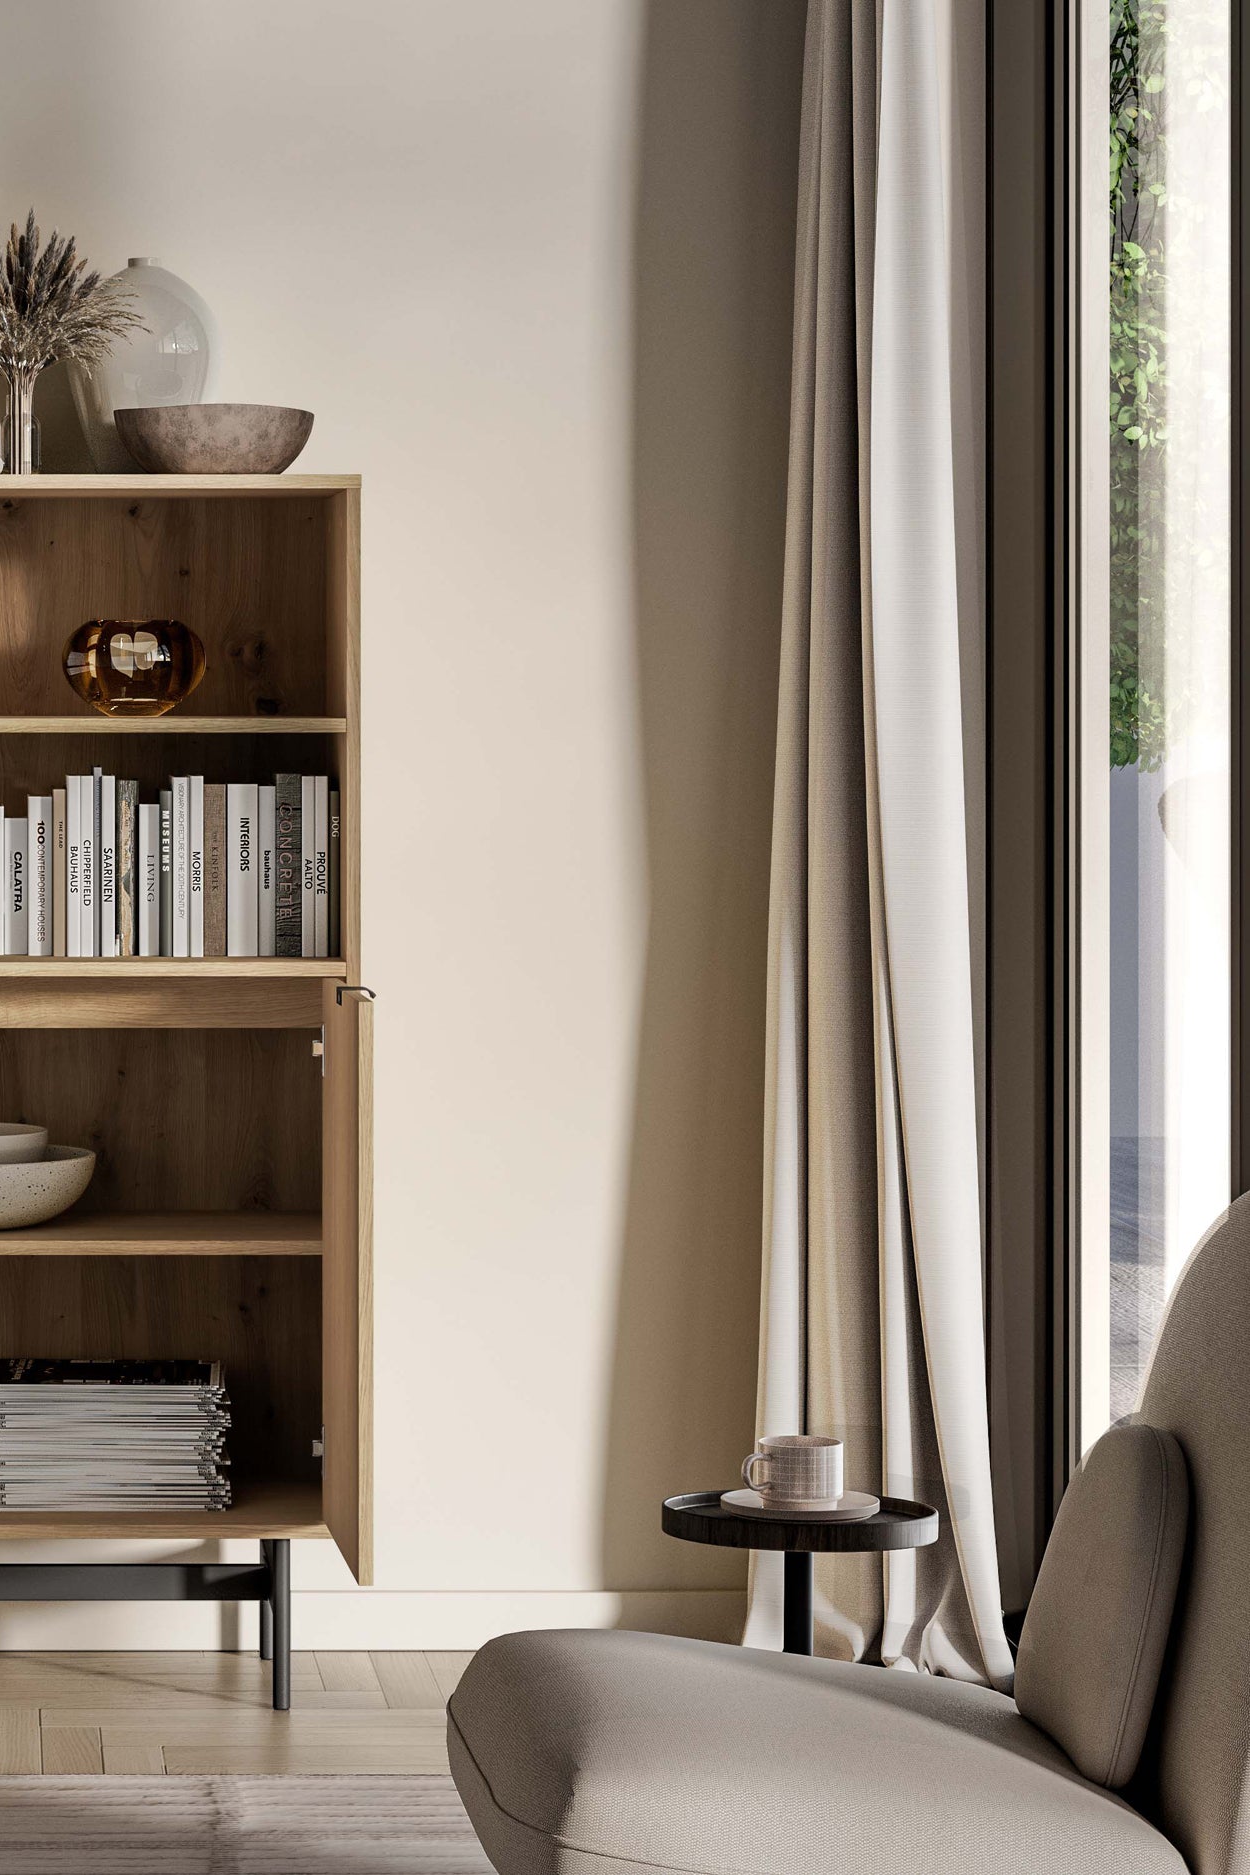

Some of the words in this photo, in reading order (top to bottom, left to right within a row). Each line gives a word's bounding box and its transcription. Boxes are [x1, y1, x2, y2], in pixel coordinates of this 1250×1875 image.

[162, 810, 170, 872] MUSEUMS
[240, 817, 250, 872] INTERIORS
[332, 816, 340, 838] DOG
[13, 851, 23, 912] CALATRA
[70, 846, 79, 893] BAUHAUS
[83, 839, 92, 907] CHIPPERFIELD
[103, 848, 113, 903] SAARINEN
[146, 854, 155, 903] LIVING
[192, 851, 201, 892] MORRIS
[211, 846, 219, 892] KINFOLK
[264, 850, 272, 890] bauhaus
[279, 804, 293, 918] CONCRETE
[304, 858, 313, 890] AALTO
[316, 851, 328, 895] PROUVÉ
[37, 910, 46, 942] HOUSES
